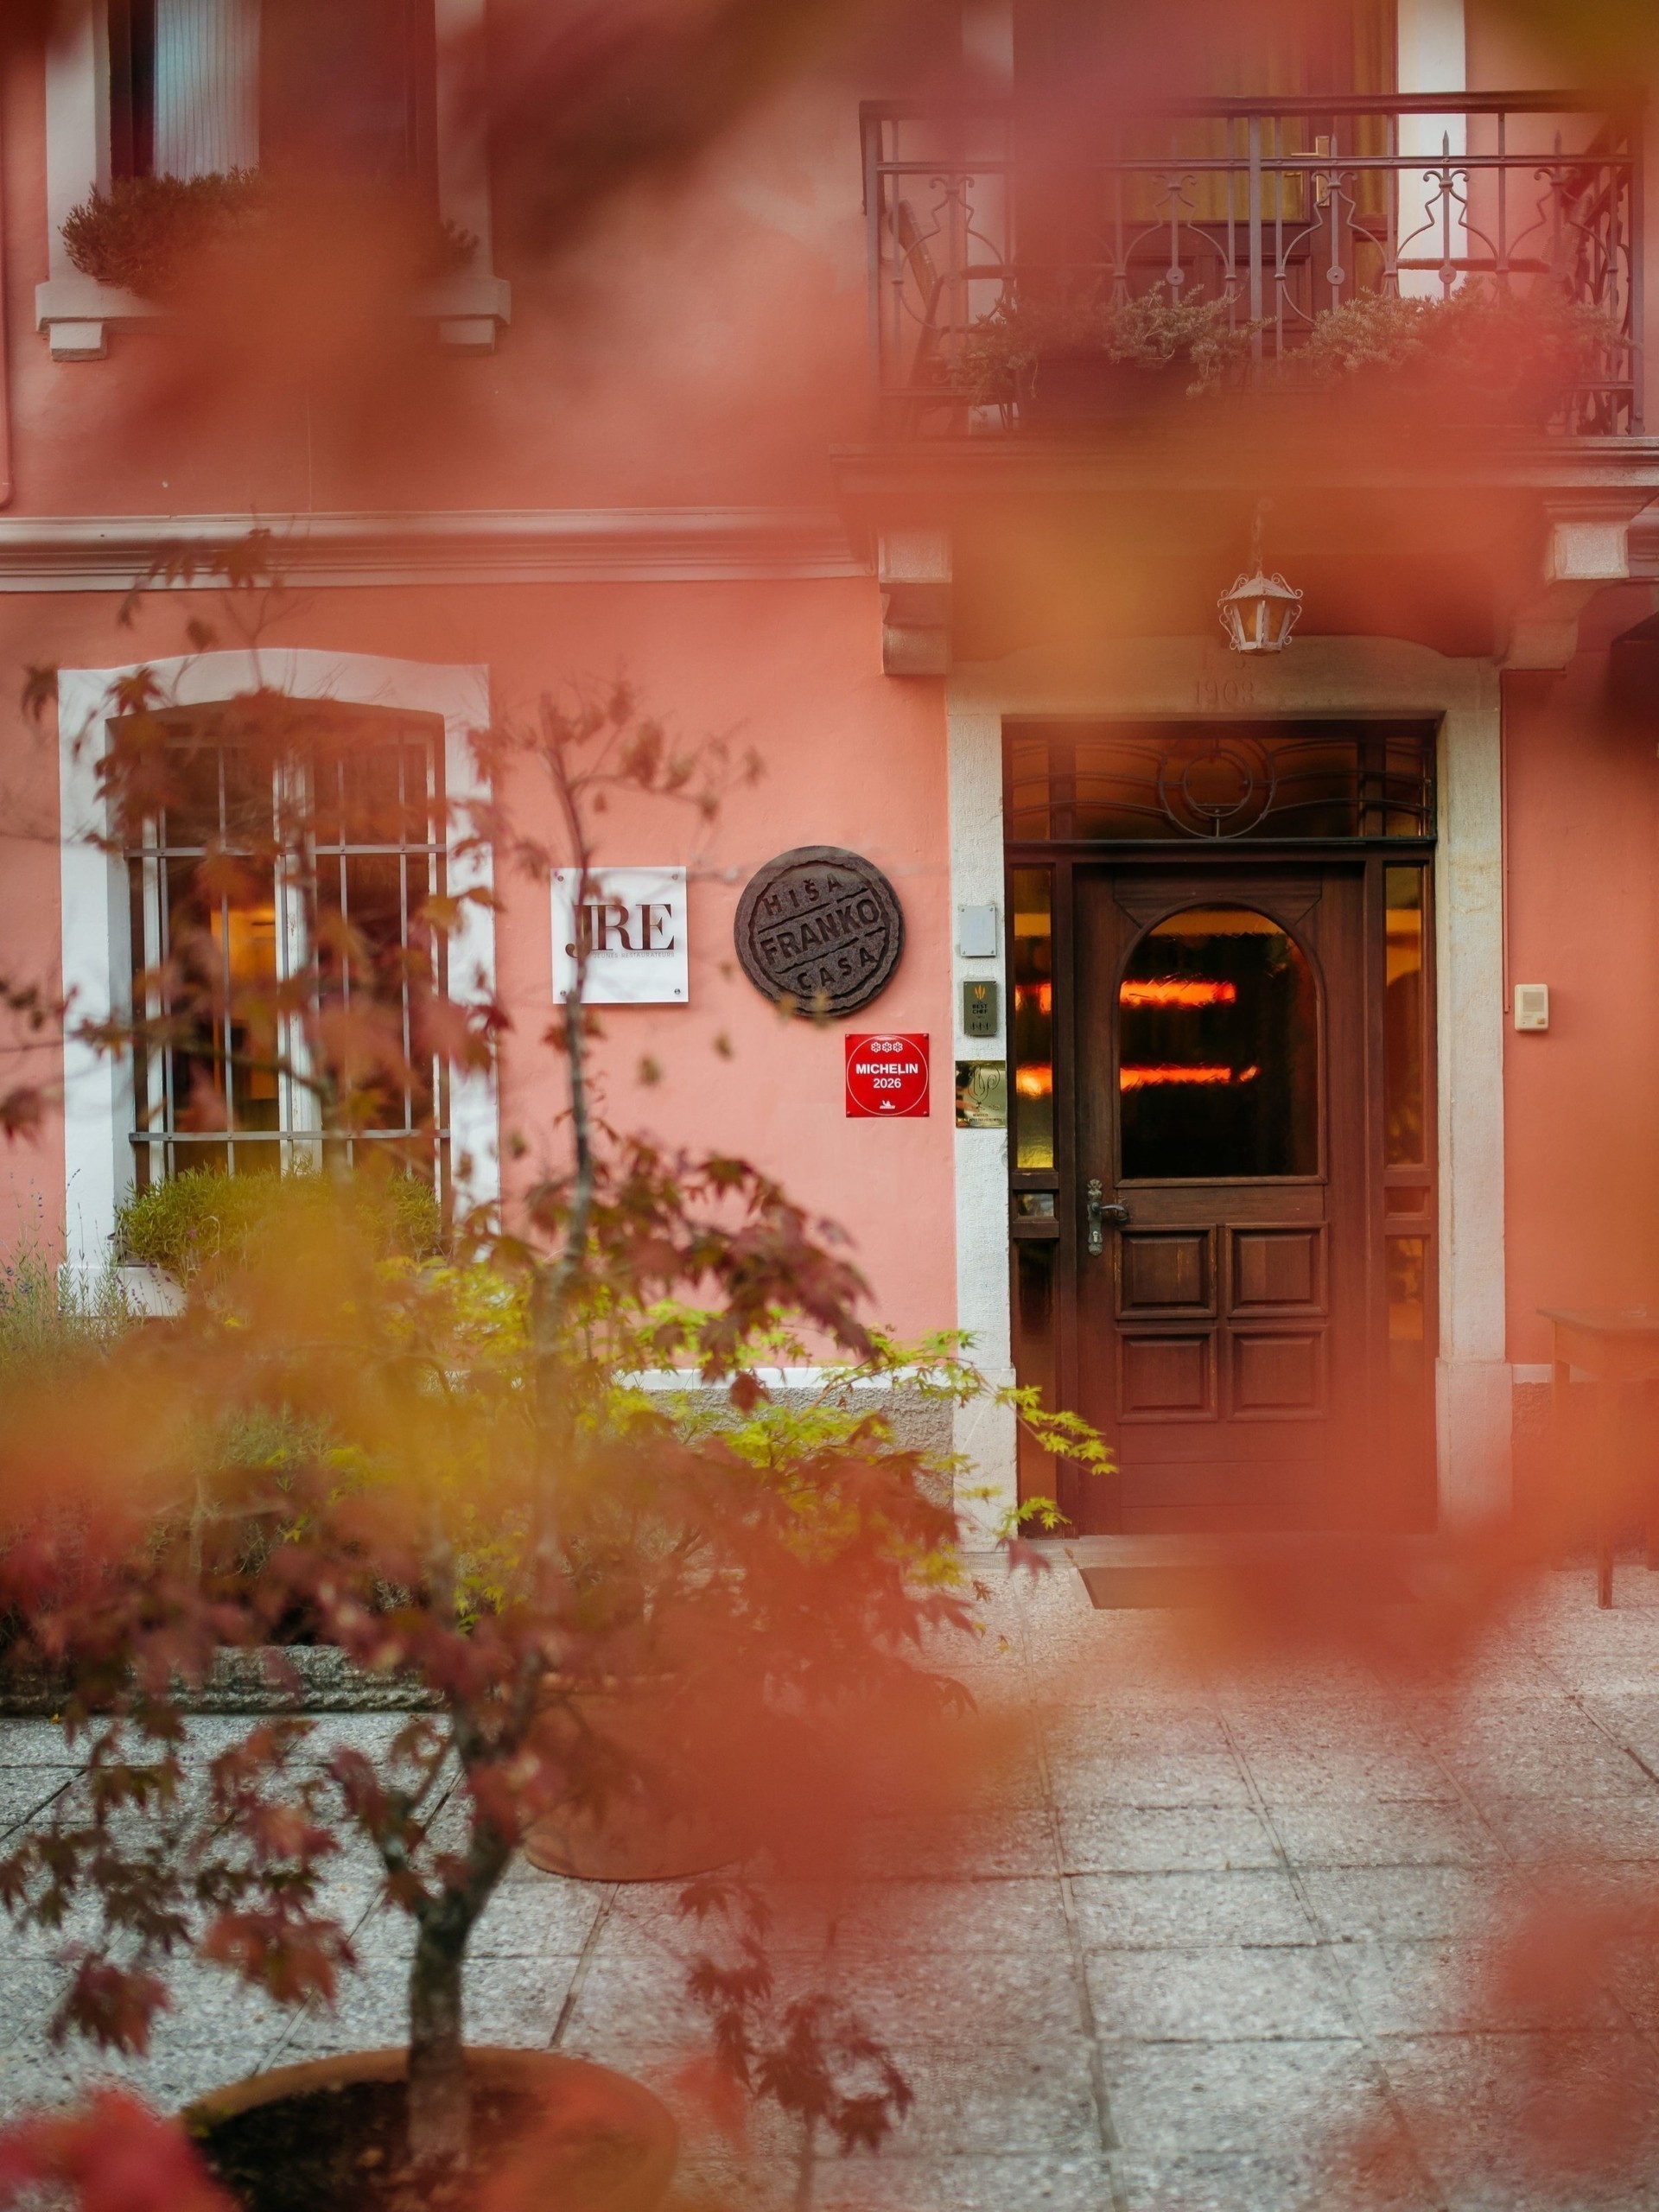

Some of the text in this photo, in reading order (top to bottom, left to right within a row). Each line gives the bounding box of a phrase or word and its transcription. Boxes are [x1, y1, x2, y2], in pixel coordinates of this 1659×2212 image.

[762, 874, 842, 916] HIŠA
[565, 904, 674, 958] JRE
[760, 899, 880, 965] FRANKO
[797, 947, 878, 990] CASA
[856, 1064, 918, 1074] MICHELIN
[873, 1078, 901, 1089] 2026
